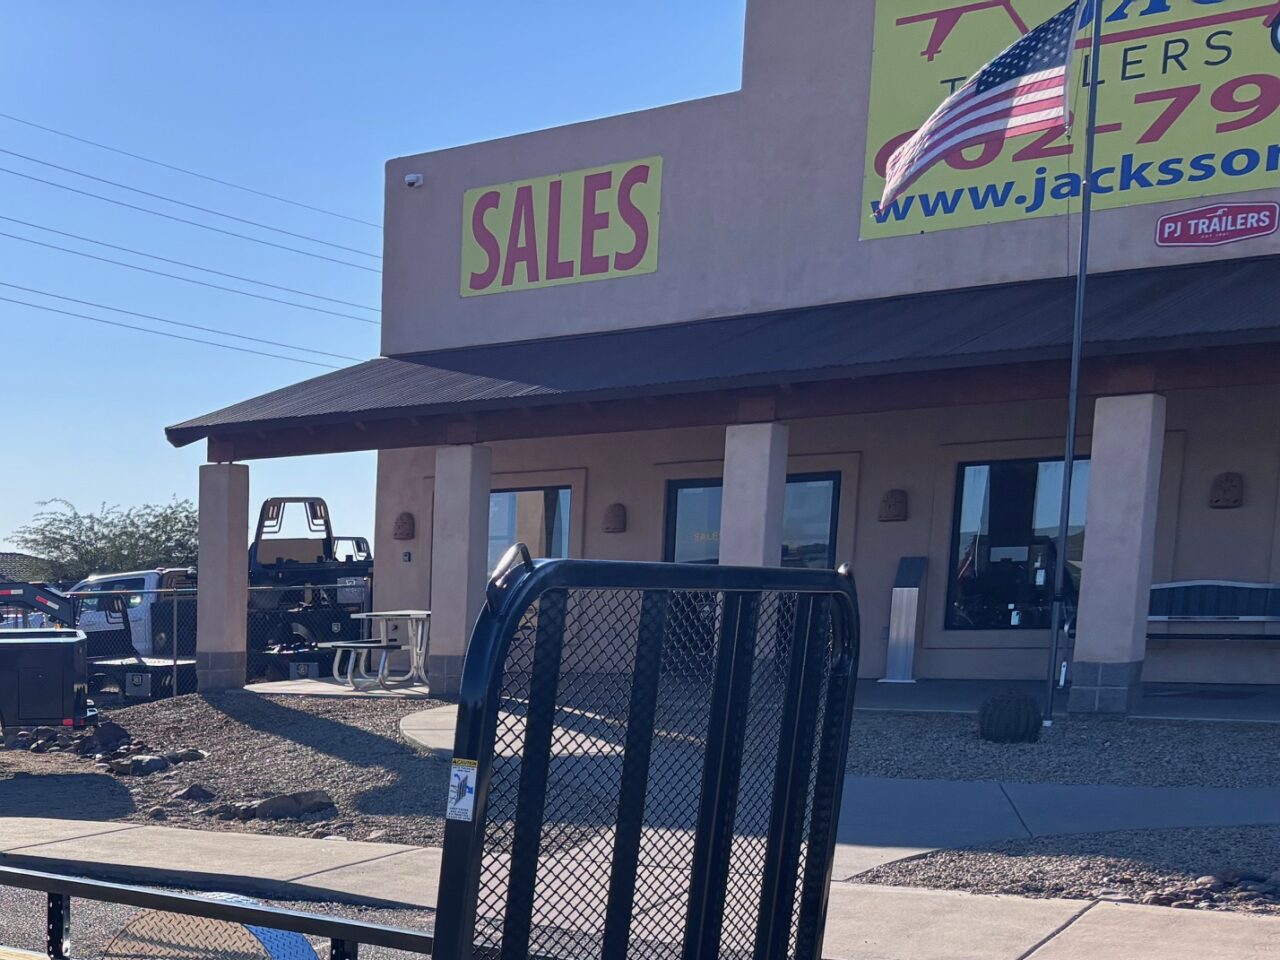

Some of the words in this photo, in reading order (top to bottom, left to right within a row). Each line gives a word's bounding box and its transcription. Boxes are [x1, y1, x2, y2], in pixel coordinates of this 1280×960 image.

[470, 165, 650, 290] SALES
[1164, 222, 1182, 238] PJ
[1187, 211, 1271, 235] TRAILERS
